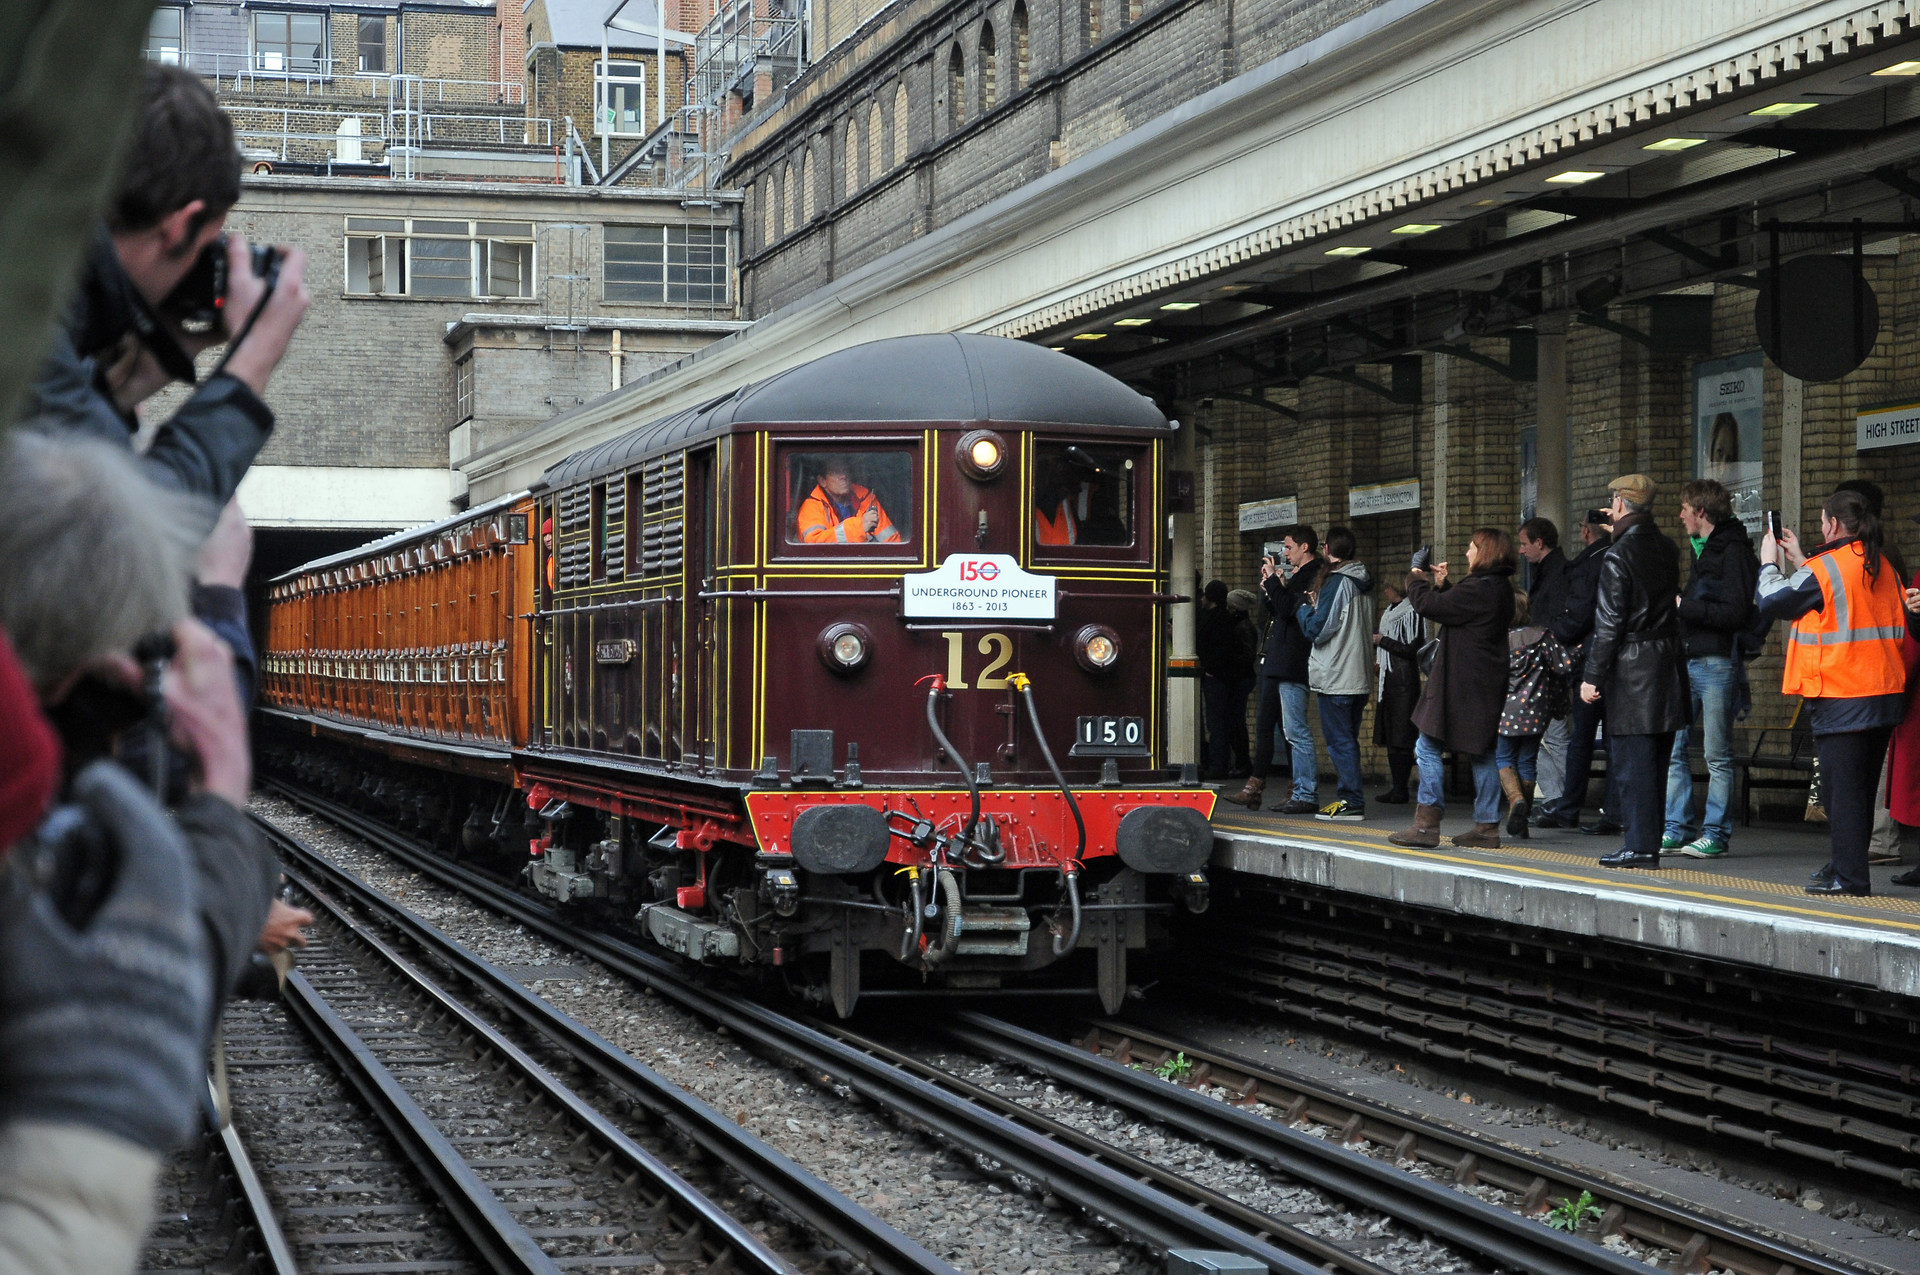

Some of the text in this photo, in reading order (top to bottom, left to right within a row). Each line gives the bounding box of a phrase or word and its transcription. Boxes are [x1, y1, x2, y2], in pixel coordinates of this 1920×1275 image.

[1720, 380, 1745, 395] SEIKO
[1866, 417, 1920, 439] HIGH STREET
[960, 561, 999, 581] 150
[911, 587, 1048, 599] UNDERGROUND PIONEER
[952, 602, 975, 611] 1863
[986, 602, 1008, 612] 2013
[942, 632, 1013, 690] 12
[1086, 721, 1139, 743] 150
[771, 842, 778, 851] A
